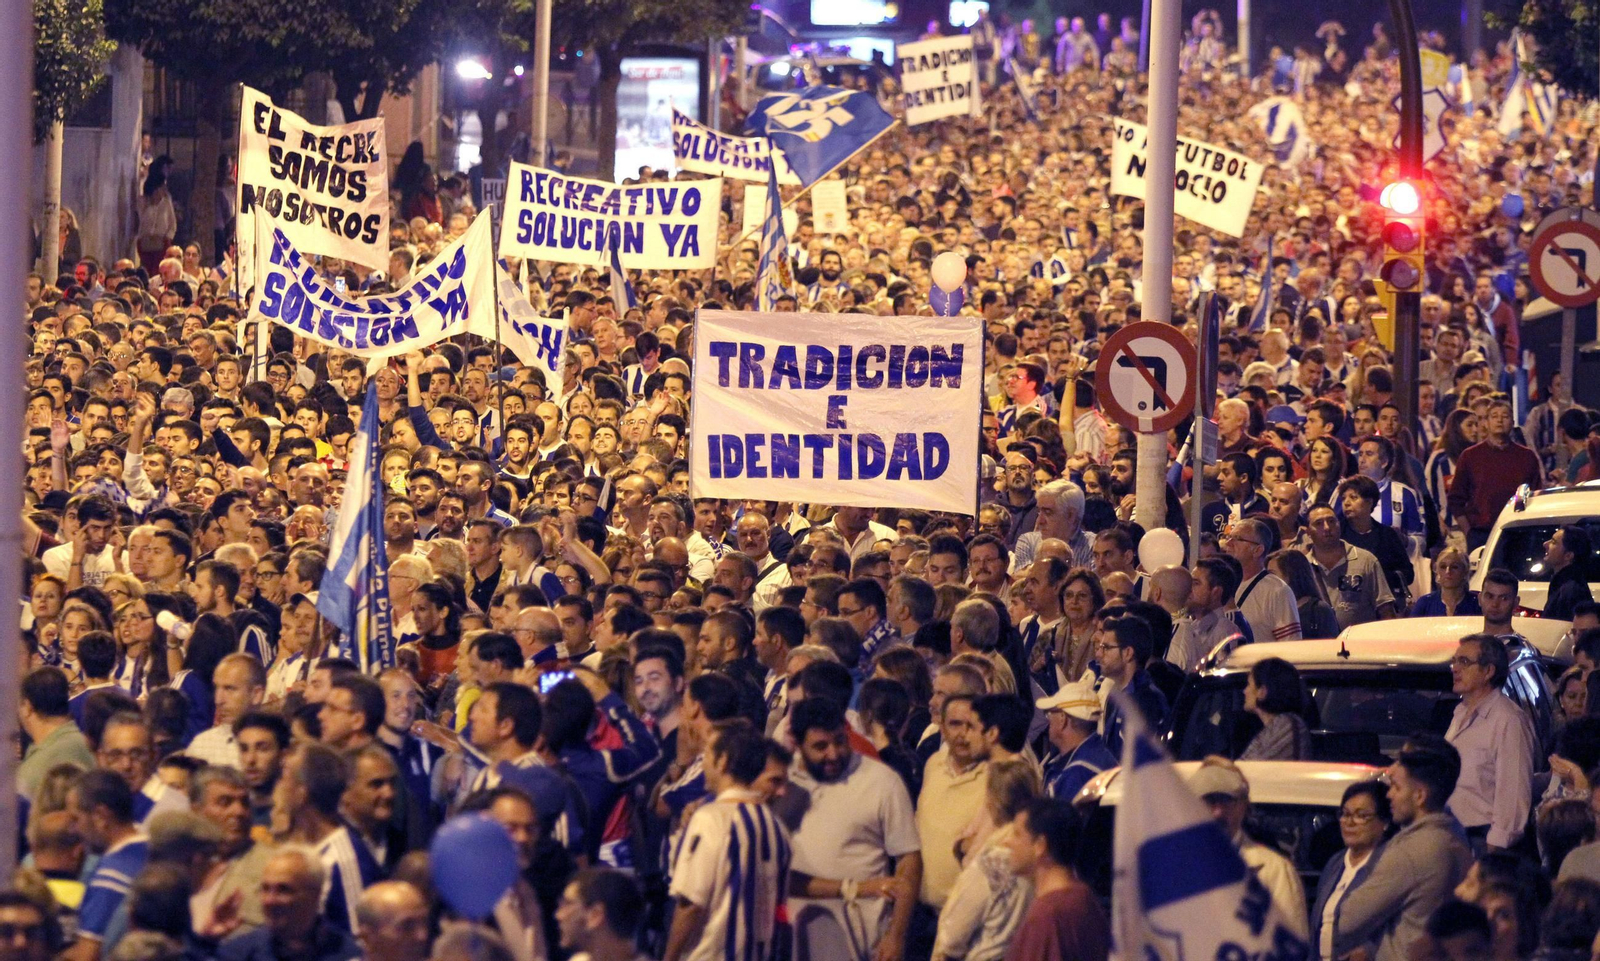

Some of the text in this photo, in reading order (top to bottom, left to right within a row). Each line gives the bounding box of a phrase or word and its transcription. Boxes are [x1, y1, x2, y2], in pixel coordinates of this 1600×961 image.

[253, 101, 380, 163] EL RECRE
[268, 146, 367, 203] SOMOS
[520, 169, 702, 217] RECREATIVO
[240, 183, 381, 244] NOSOTROS
[517, 209, 644, 254] SOLUCION
[660, 224, 700, 258] YA
[259, 271, 469, 349] SOLUCION YA
[709, 341, 964, 391] TRADICION
[826, 395, 848, 429] E
[707, 432, 950, 480] IDENTIDAD
